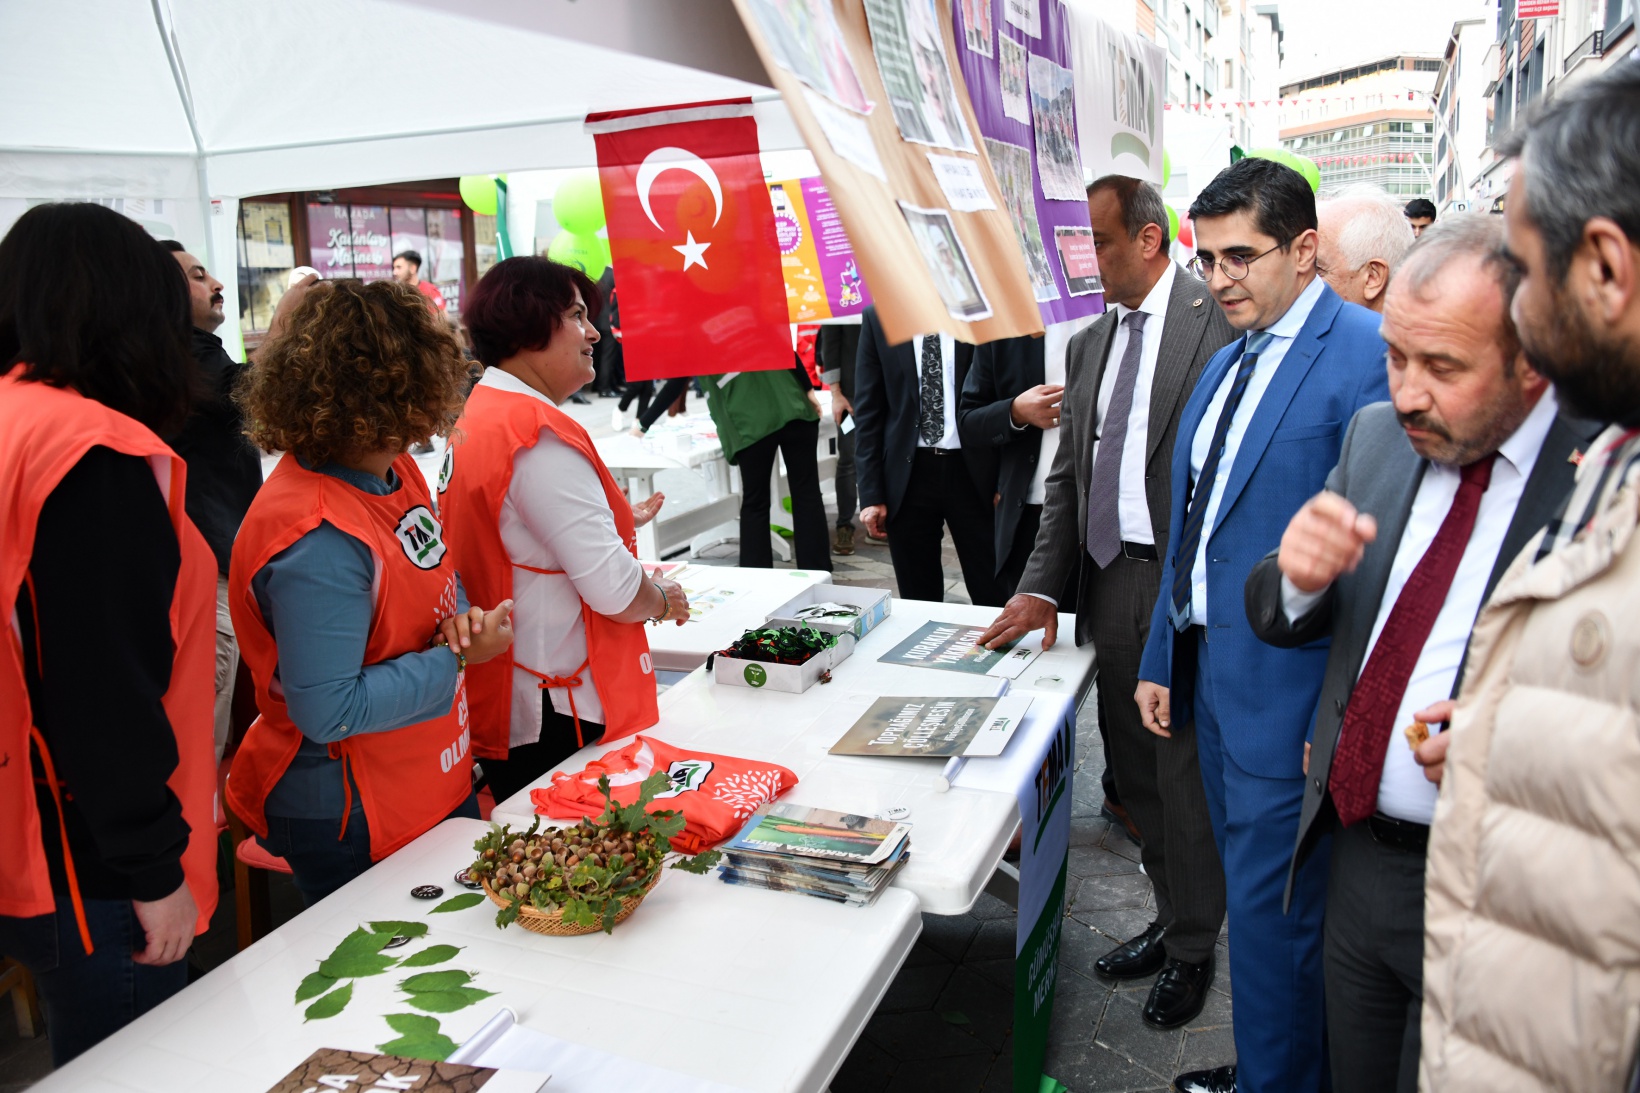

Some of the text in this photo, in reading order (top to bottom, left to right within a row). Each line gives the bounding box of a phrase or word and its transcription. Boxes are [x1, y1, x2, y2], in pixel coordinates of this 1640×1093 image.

[901, 626, 960, 660] KURAKLIK
[932, 630, 985, 664] YAKMASIN
[440, 725, 470, 773] OLM
[1034, 728, 1064, 823] TEMA
